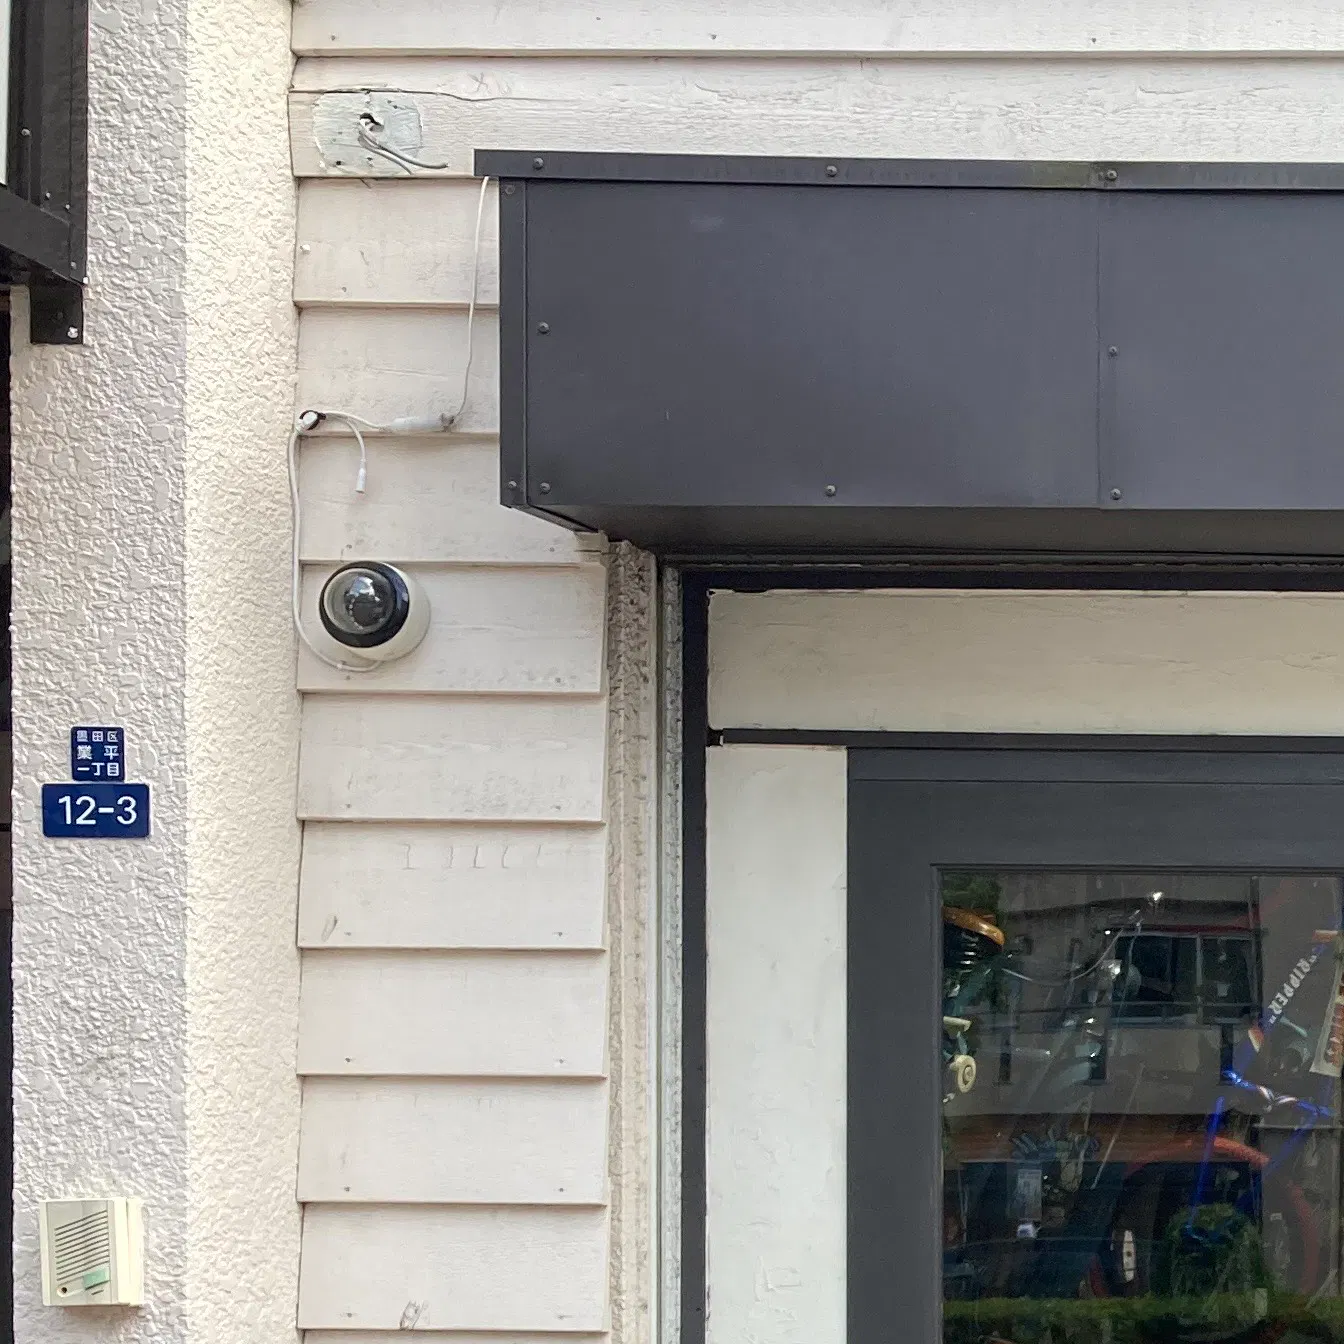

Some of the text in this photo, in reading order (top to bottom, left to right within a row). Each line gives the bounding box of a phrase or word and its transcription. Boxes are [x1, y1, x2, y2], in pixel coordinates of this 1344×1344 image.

[76, 744, 120, 760] 業平
[76, 762, 120, 777] 一丁目
[57, 795, 138, 826] 12-3
